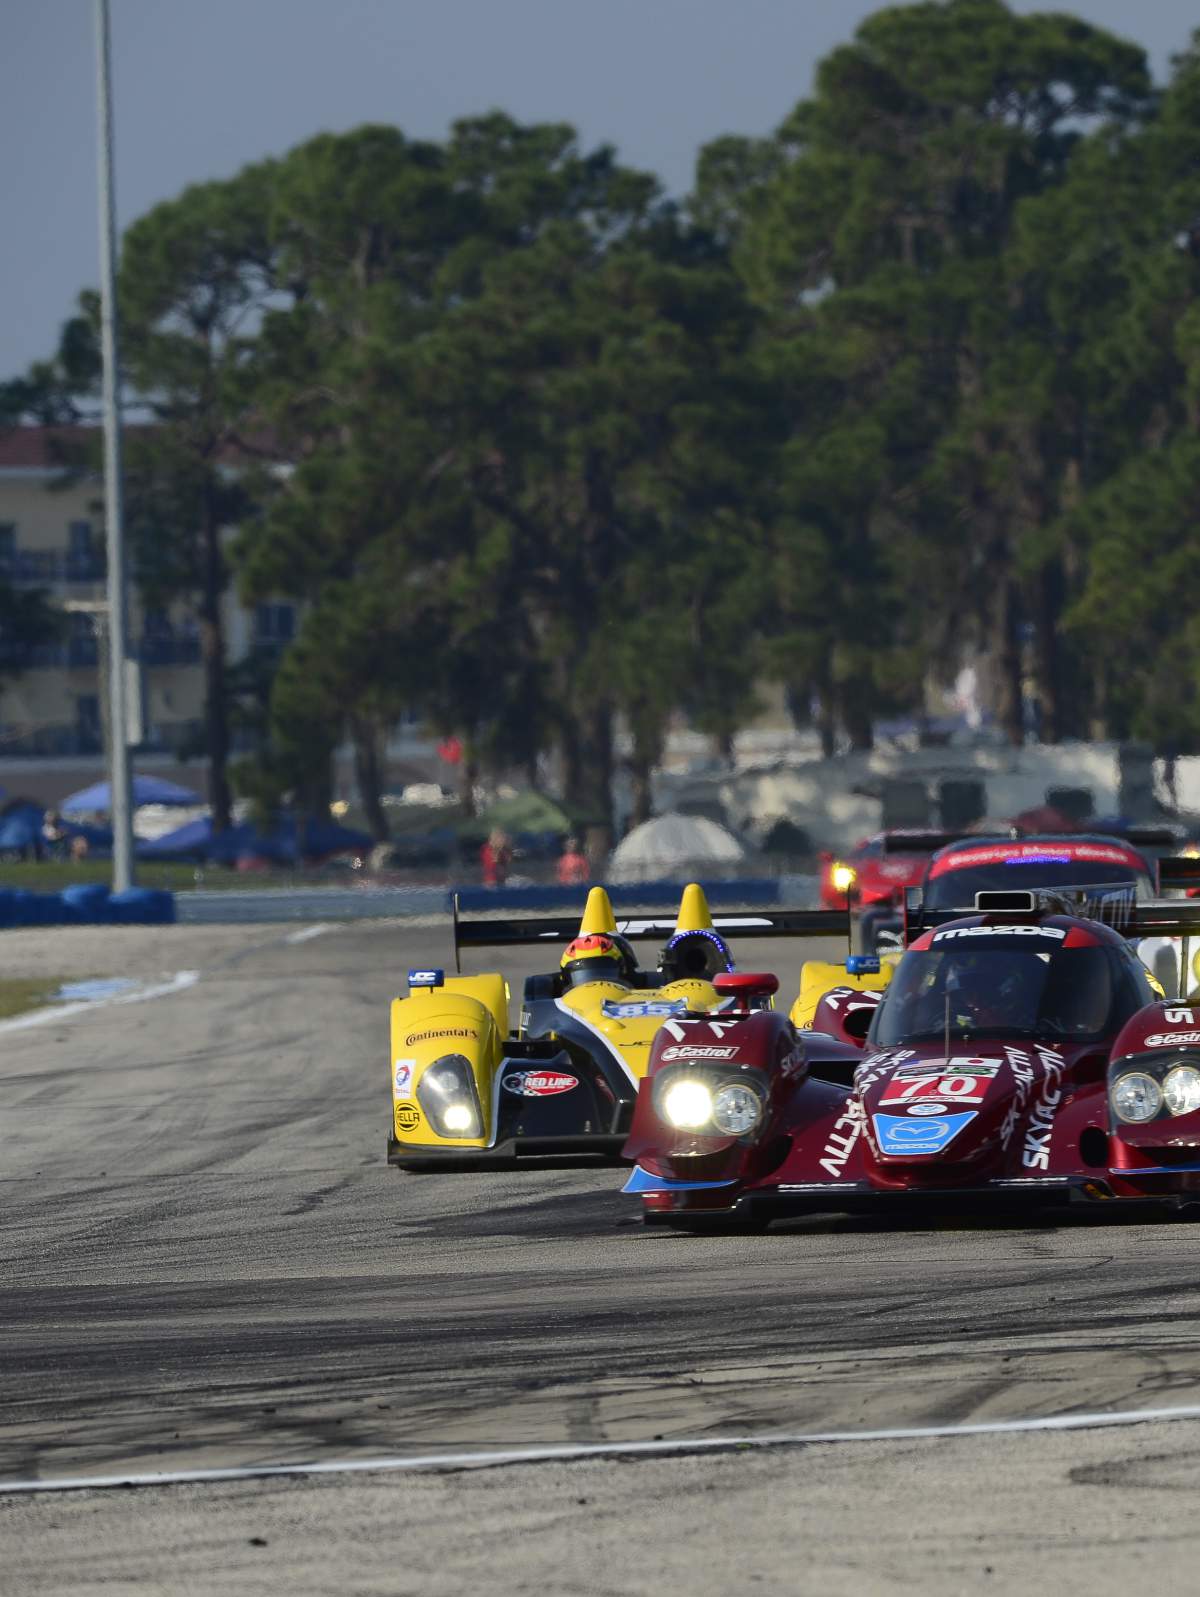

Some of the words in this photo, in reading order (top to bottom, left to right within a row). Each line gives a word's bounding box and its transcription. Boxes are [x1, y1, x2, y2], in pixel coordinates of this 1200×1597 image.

[618, 1004, 669, 1016] 85
[405, 1029, 469, 1046] Continental
[678, 1046, 732, 1058] Castrol
[525, 1077, 546, 1087] RED
[548, 1076, 574, 1086] LINE
[900, 1076, 978, 1097] 70
